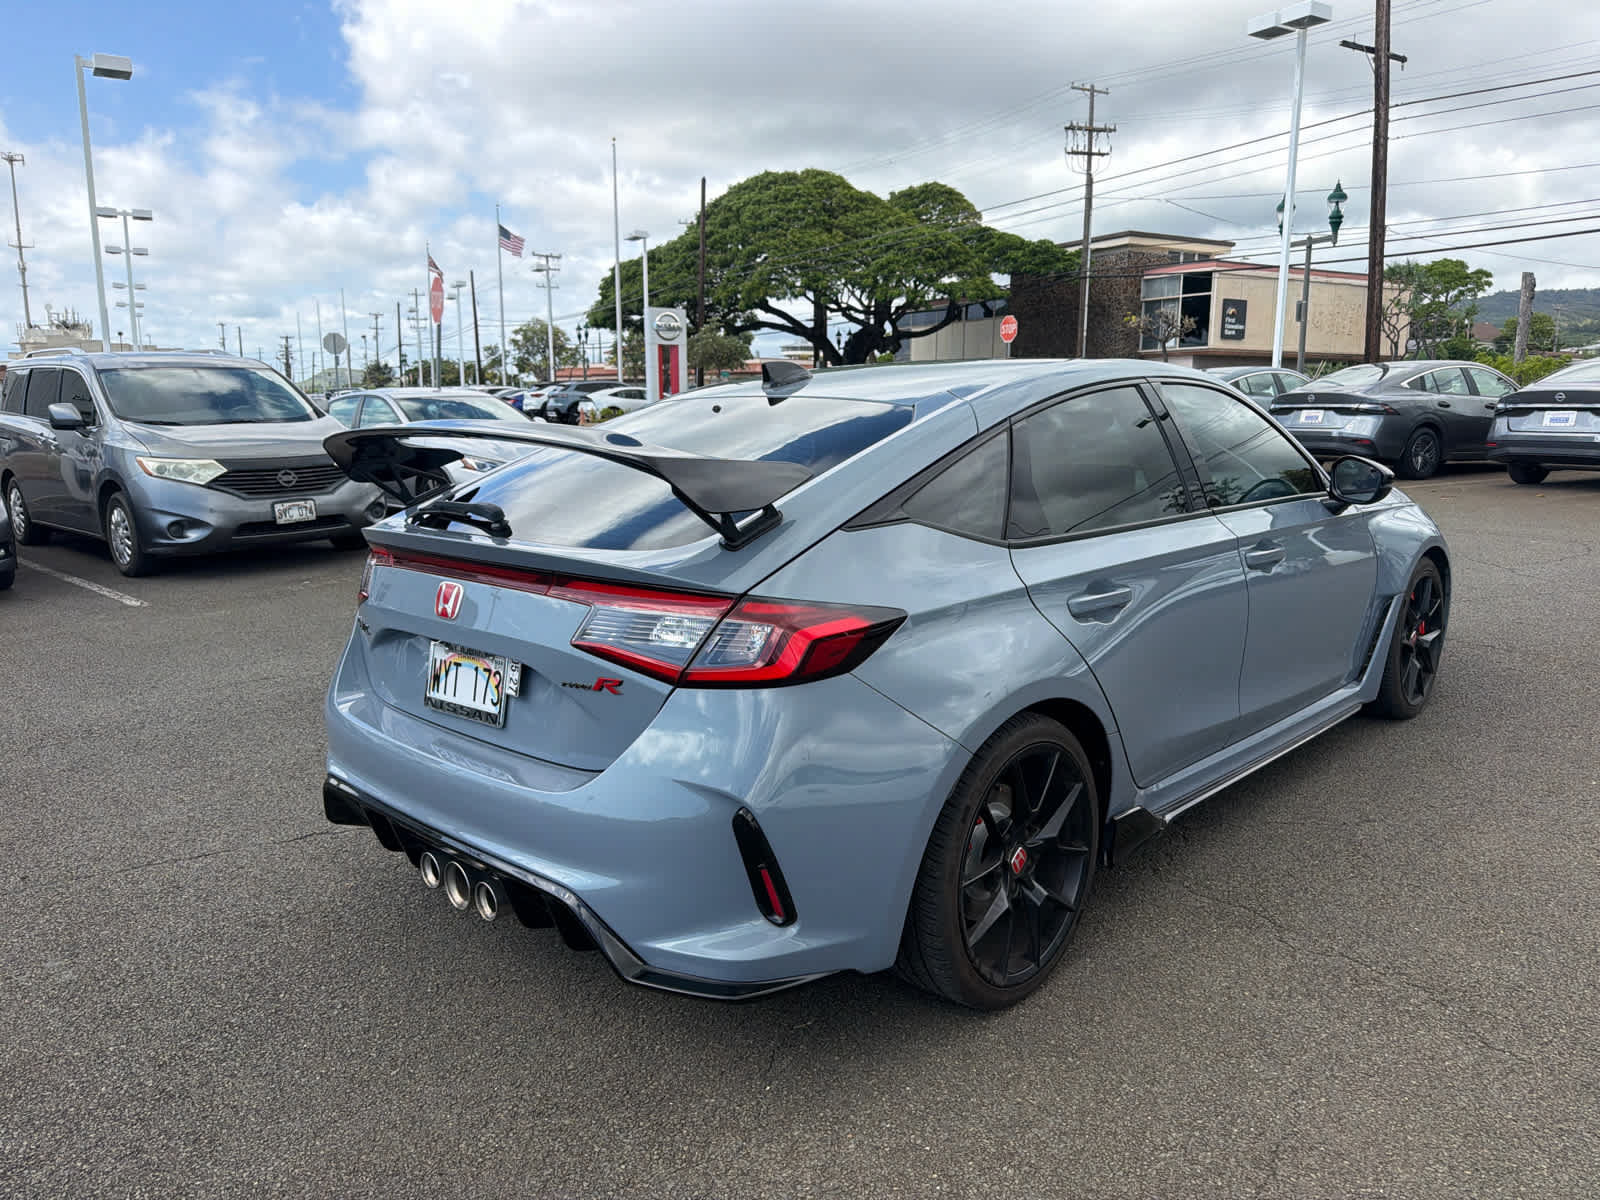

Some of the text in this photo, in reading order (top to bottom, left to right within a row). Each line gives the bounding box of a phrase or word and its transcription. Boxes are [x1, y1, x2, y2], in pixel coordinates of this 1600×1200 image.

[1001, 324, 1017, 334] STOP
[431, 658, 502, 707] WYT 173
[425, 696, 500, 725] NISSAN
